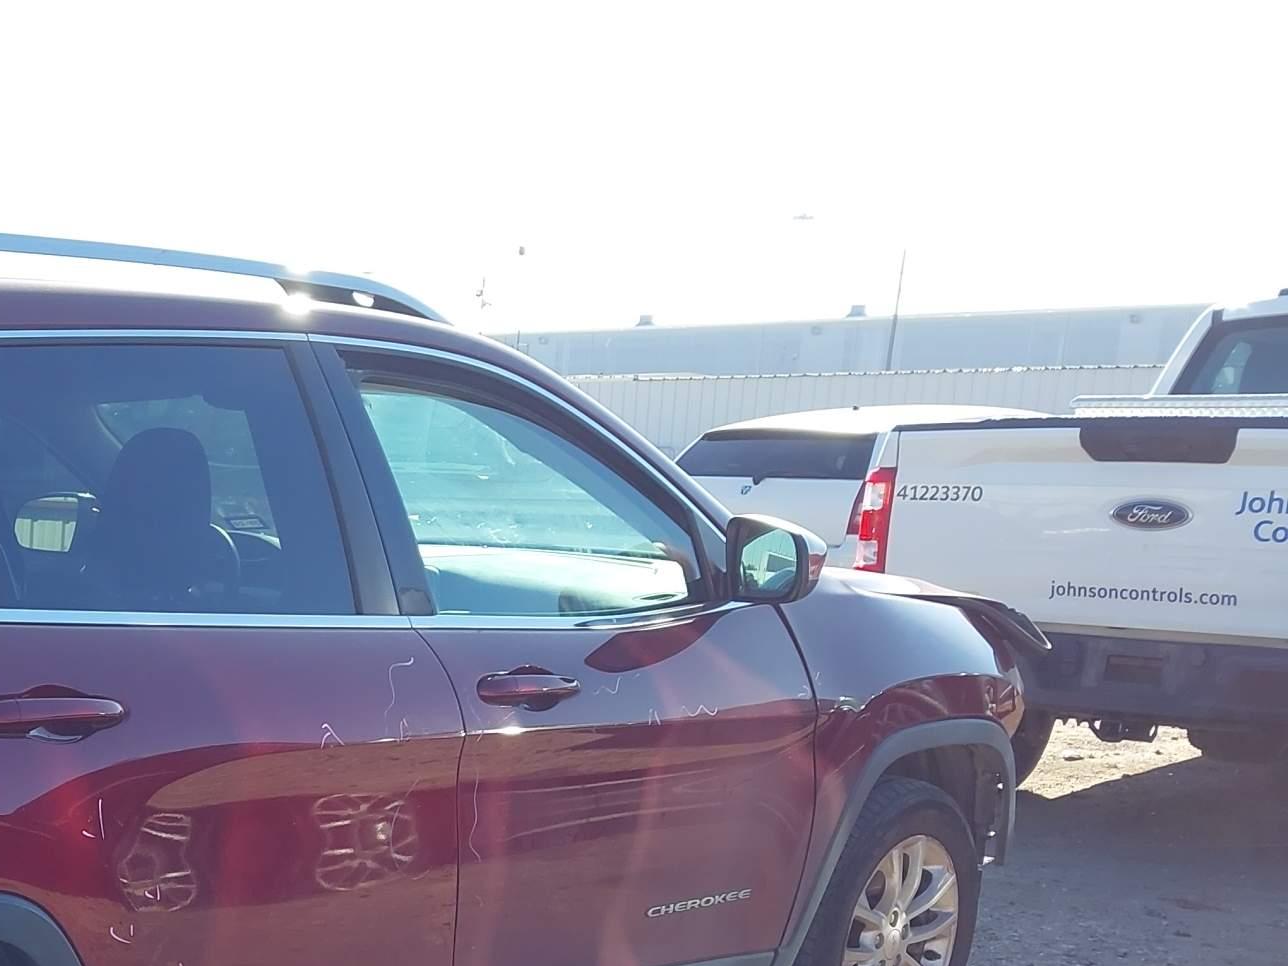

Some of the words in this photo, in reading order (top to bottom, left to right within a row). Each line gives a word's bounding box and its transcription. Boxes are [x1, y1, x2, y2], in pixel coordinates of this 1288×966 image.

[896, 485, 983, 502] 41223370
[1234, 489, 1288, 516] Joh
[1127, 503, 1175, 525] Ford
[1048, 580, 1238, 606] johnsoncontrols.com
[646, 888, 752, 918] CHEROKEE
